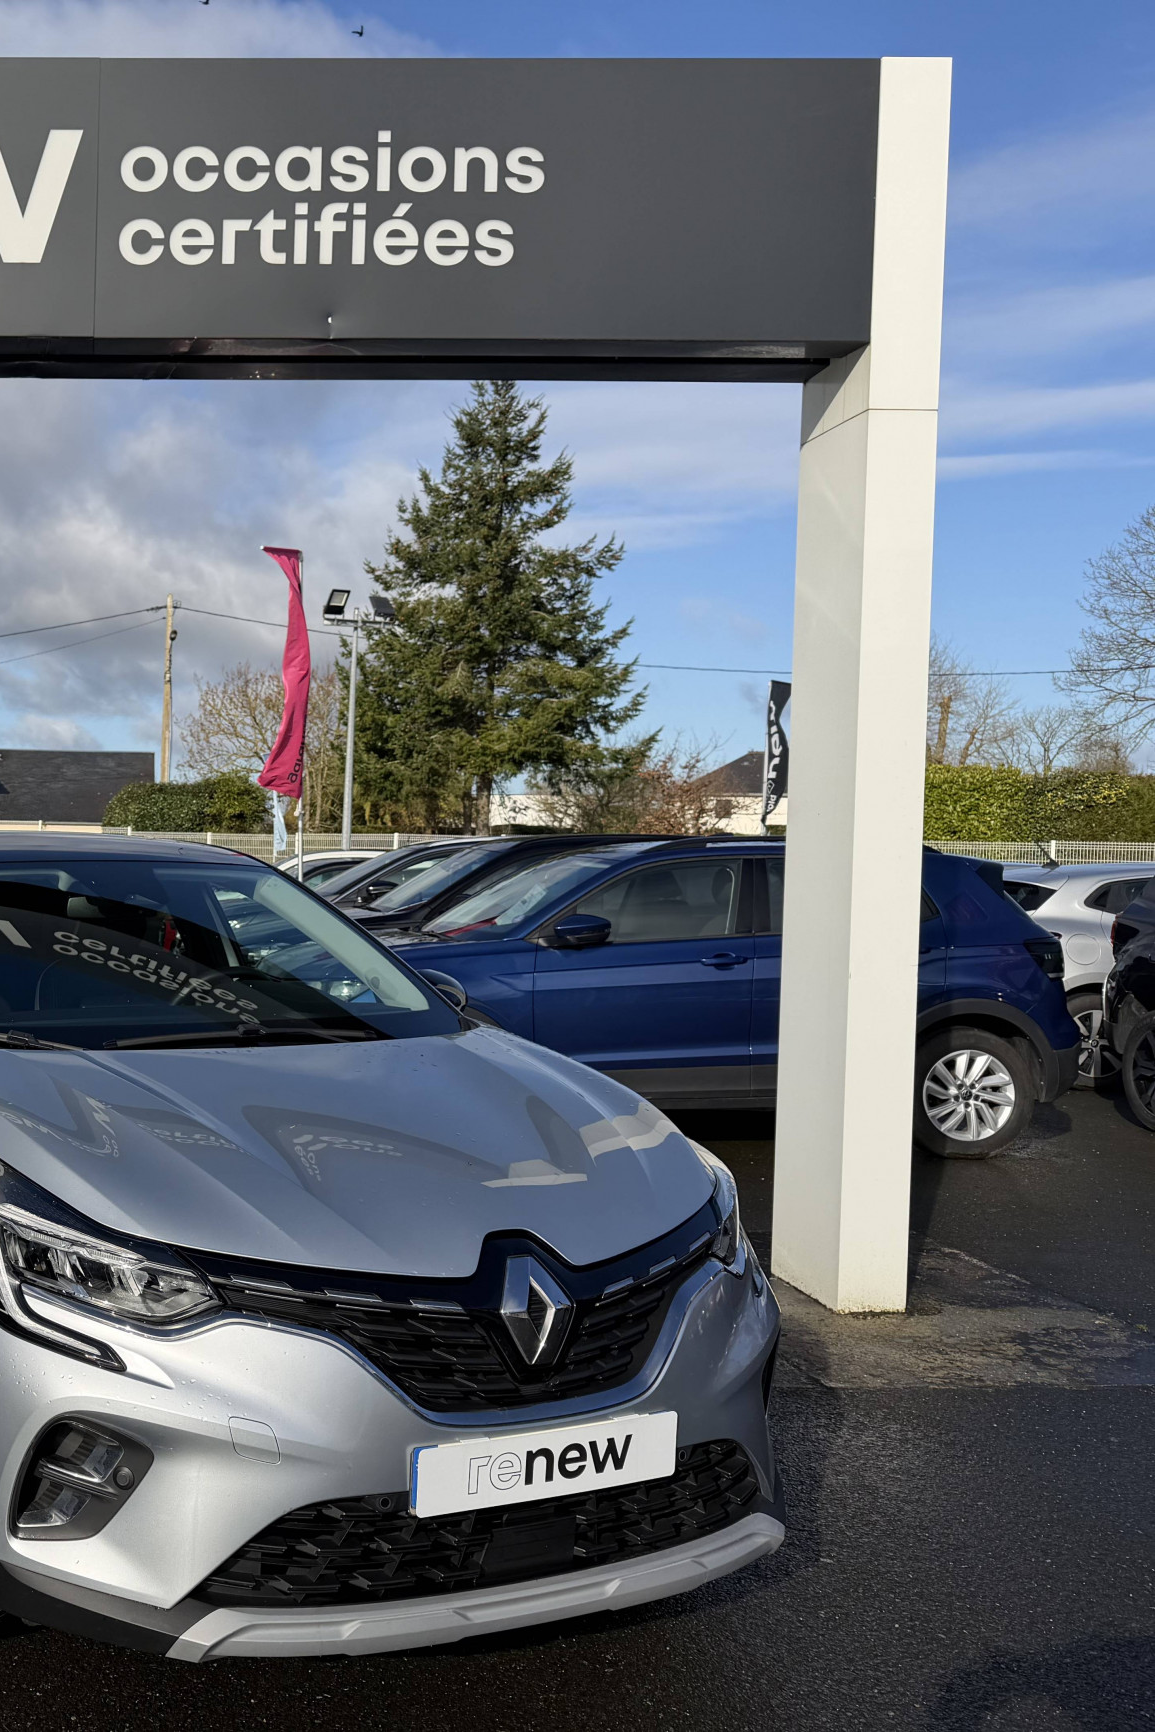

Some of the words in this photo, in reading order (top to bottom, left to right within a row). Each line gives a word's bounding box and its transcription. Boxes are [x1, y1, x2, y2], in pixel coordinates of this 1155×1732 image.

[120, 130, 545, 193] occasions
[118, 202, 515, 266] certifiées
[468, 1434, 633, 1495] renew
